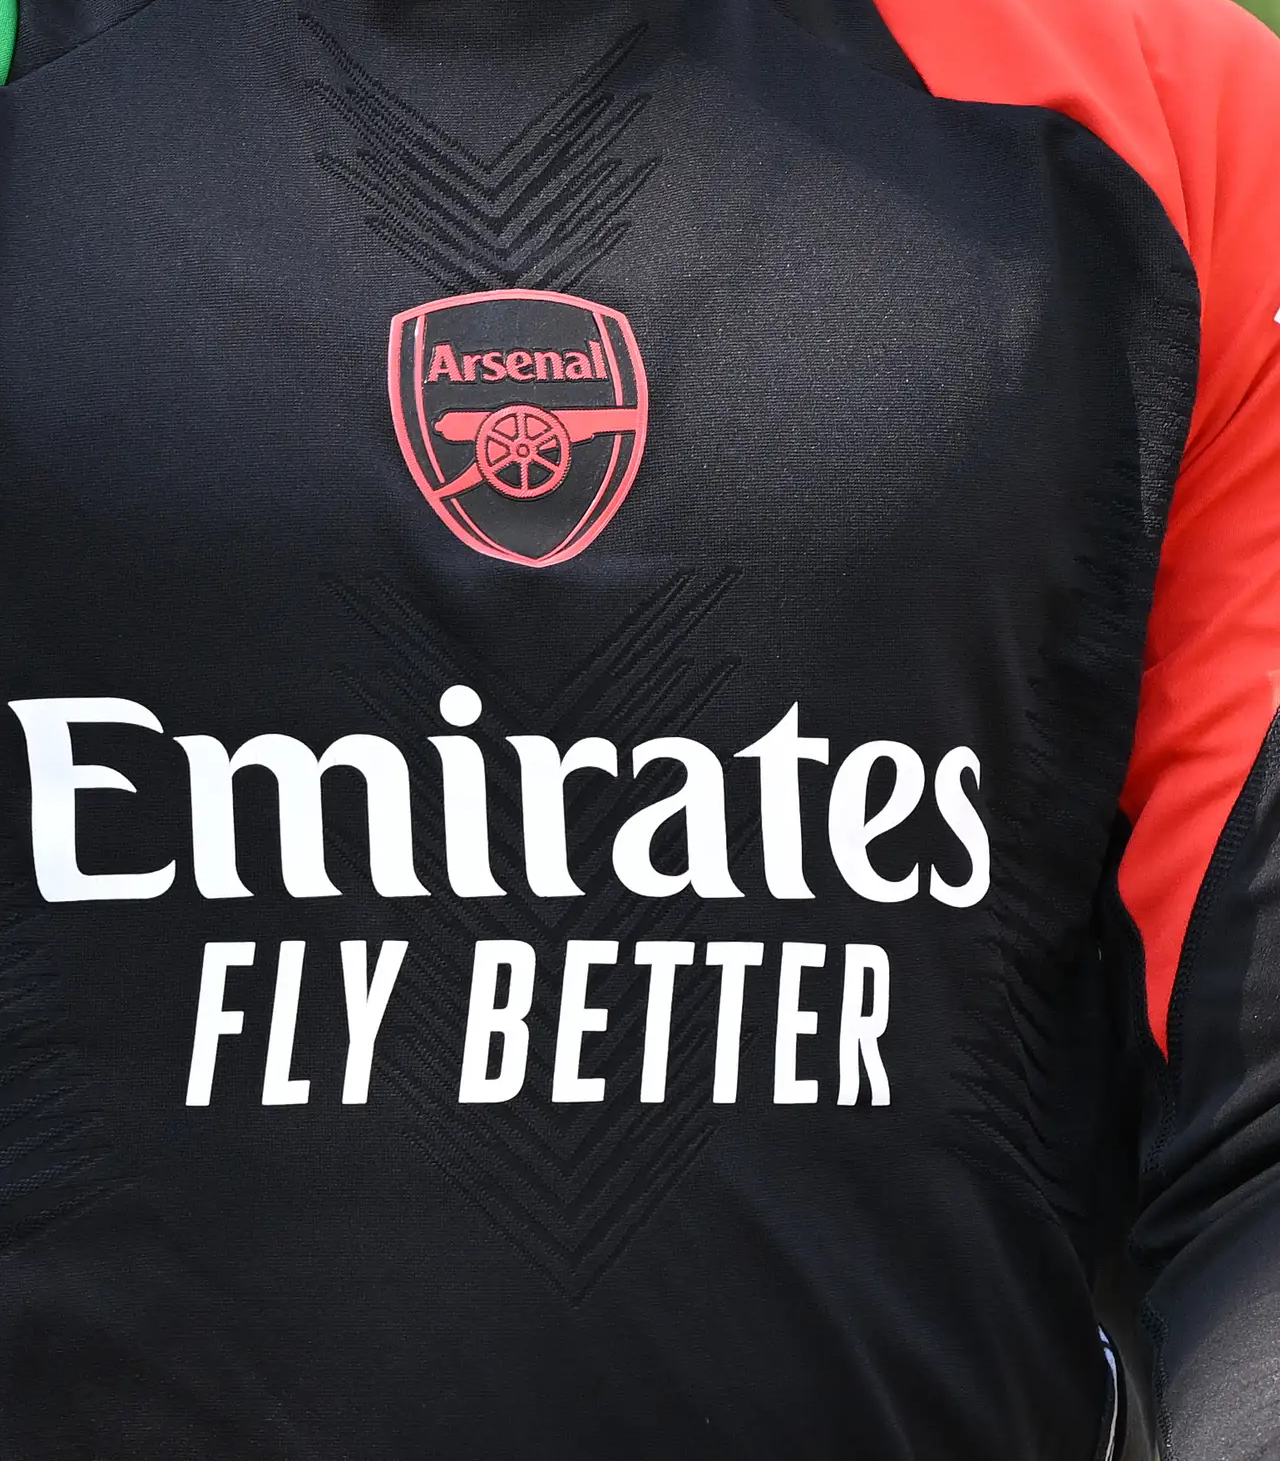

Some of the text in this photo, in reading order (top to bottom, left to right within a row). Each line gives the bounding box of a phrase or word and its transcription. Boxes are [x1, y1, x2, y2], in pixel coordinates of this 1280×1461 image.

[427, 339, 609, 383] Arsenal
[7, 684, 991, 908] Emirates
[185, 939, 891, 1107] FLY BETTER
